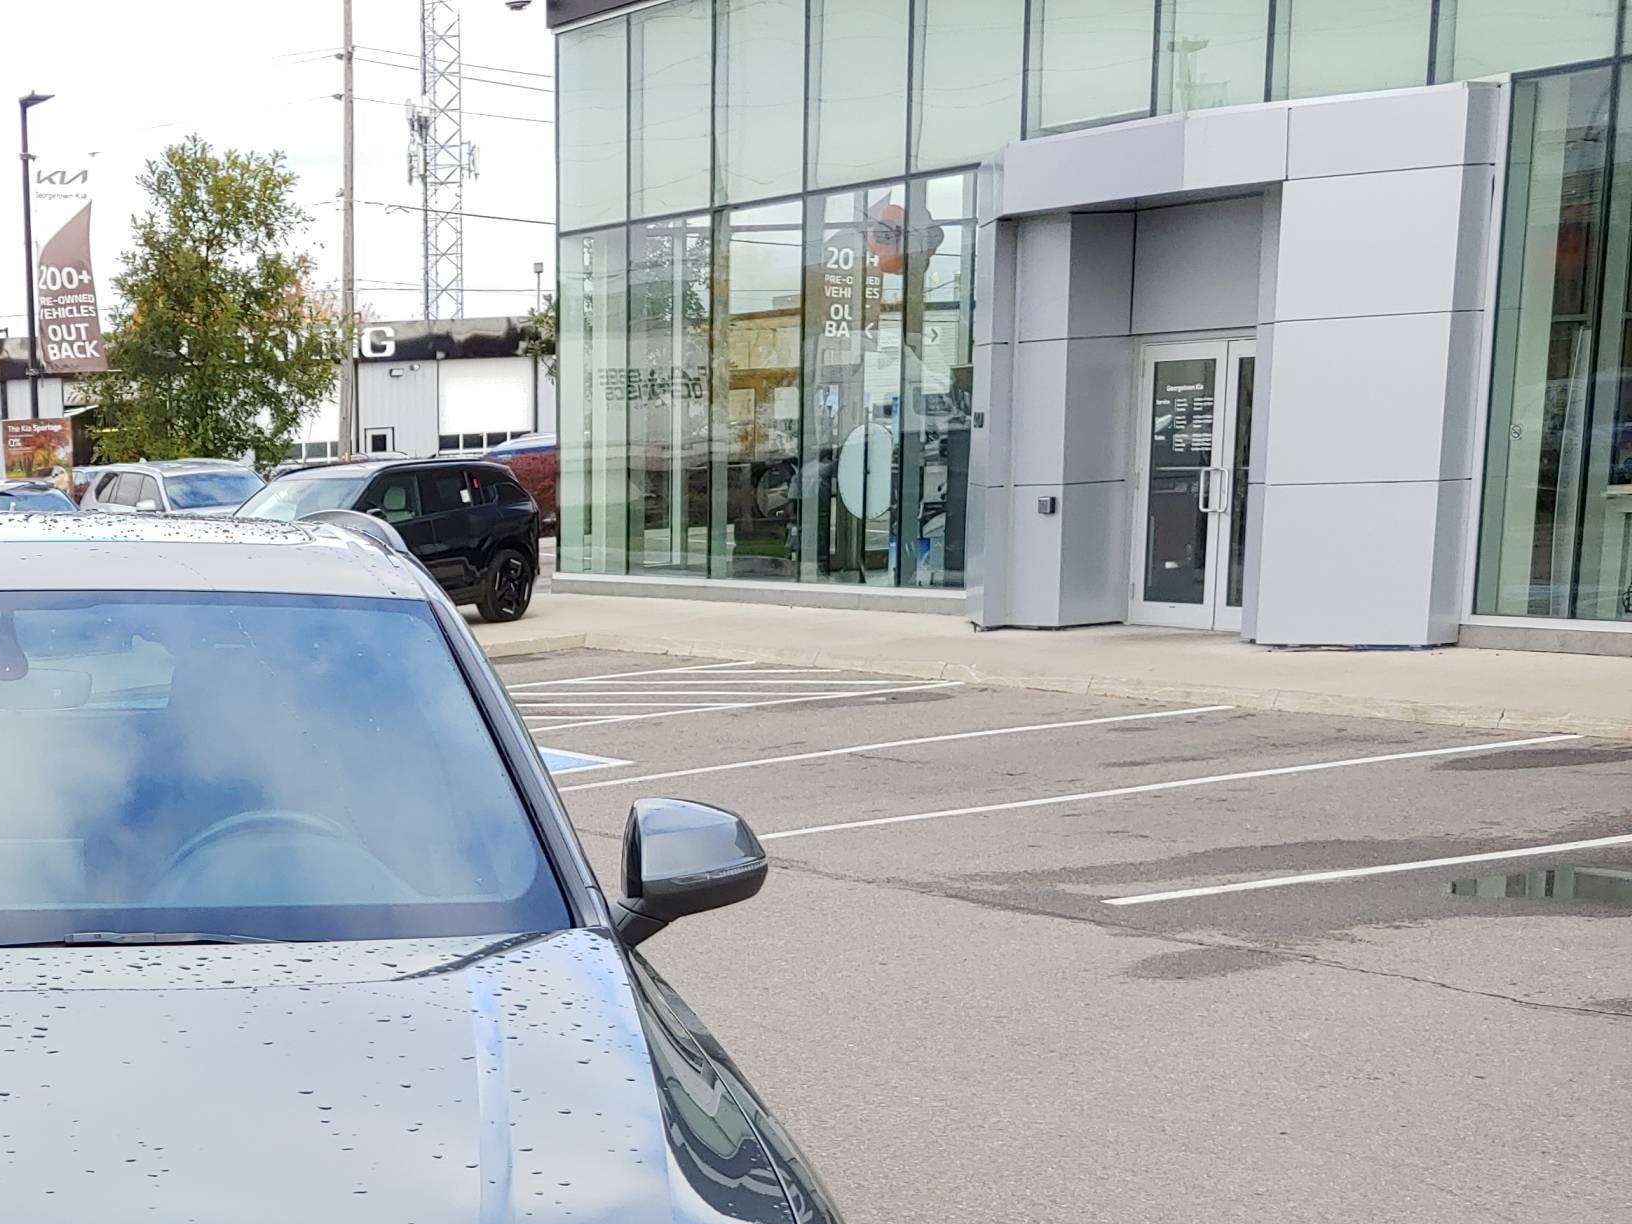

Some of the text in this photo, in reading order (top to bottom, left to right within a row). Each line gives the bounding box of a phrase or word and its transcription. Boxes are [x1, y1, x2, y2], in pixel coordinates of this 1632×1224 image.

[38, 265, 91, 290] 200+
[40, 293, 95, 306] RE-OWNED
[48, 323, 89, 341] OUT
[48, 340, 100, 360] BACK
